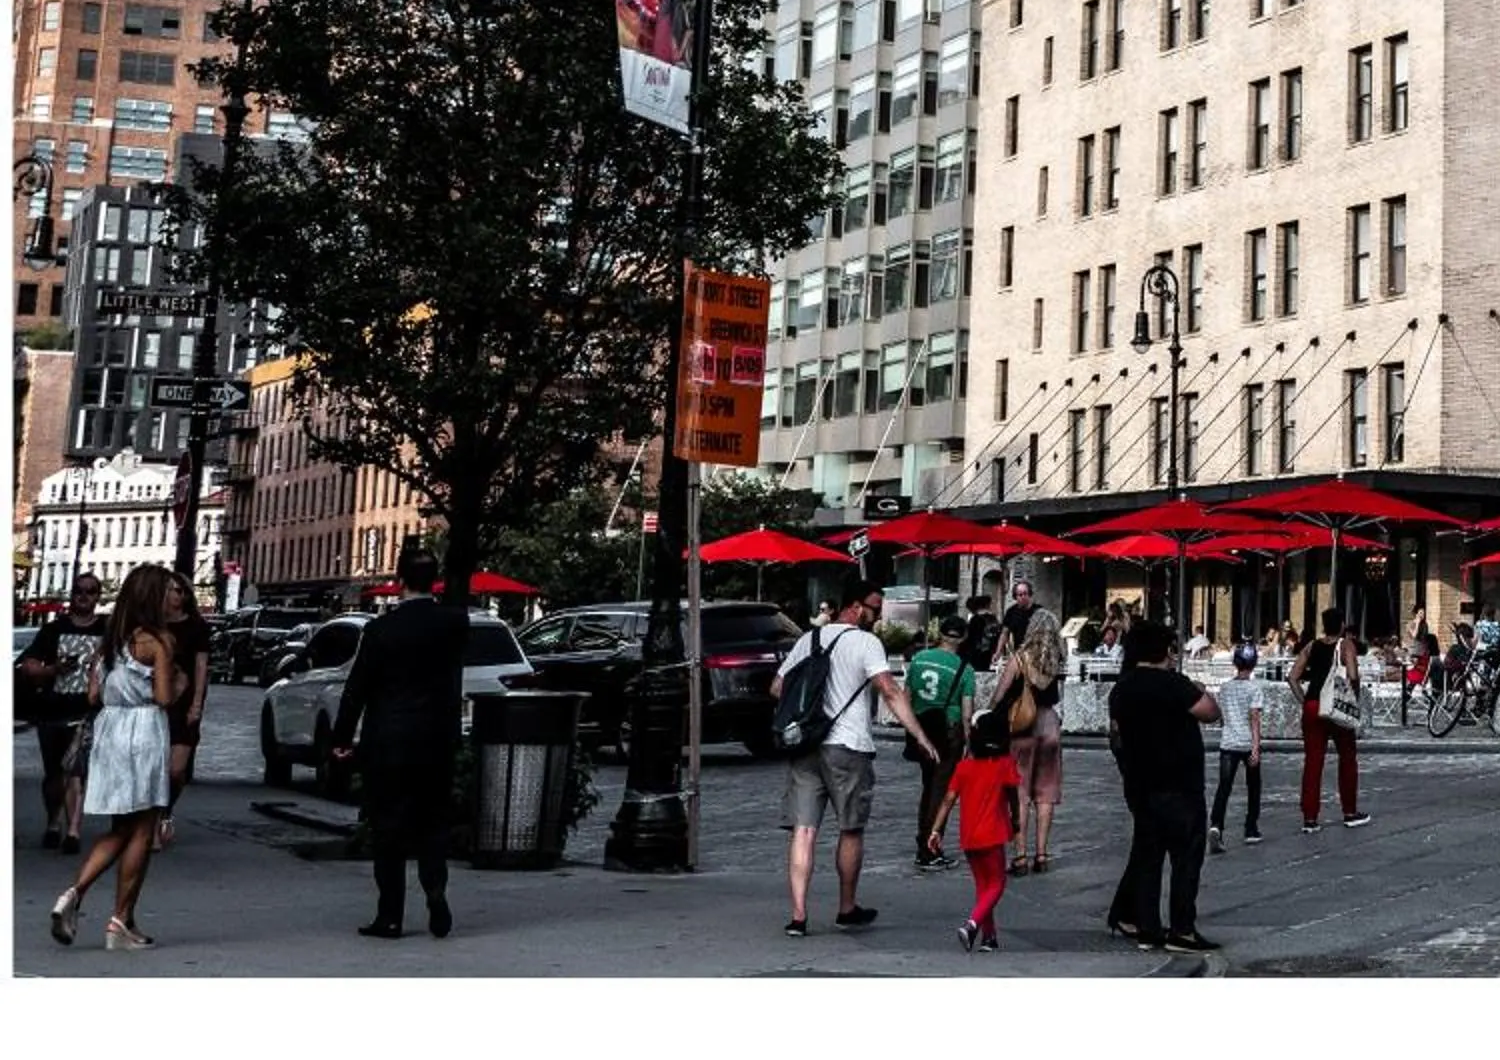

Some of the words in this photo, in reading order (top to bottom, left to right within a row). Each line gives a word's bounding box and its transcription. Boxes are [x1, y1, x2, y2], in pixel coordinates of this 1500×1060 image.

[103, 295, 153, 309] LITTLE
[159, 296, 196, 311] WEST
[728, 285, 765, 309] STREET
[918, 669, 939, 701] 3
